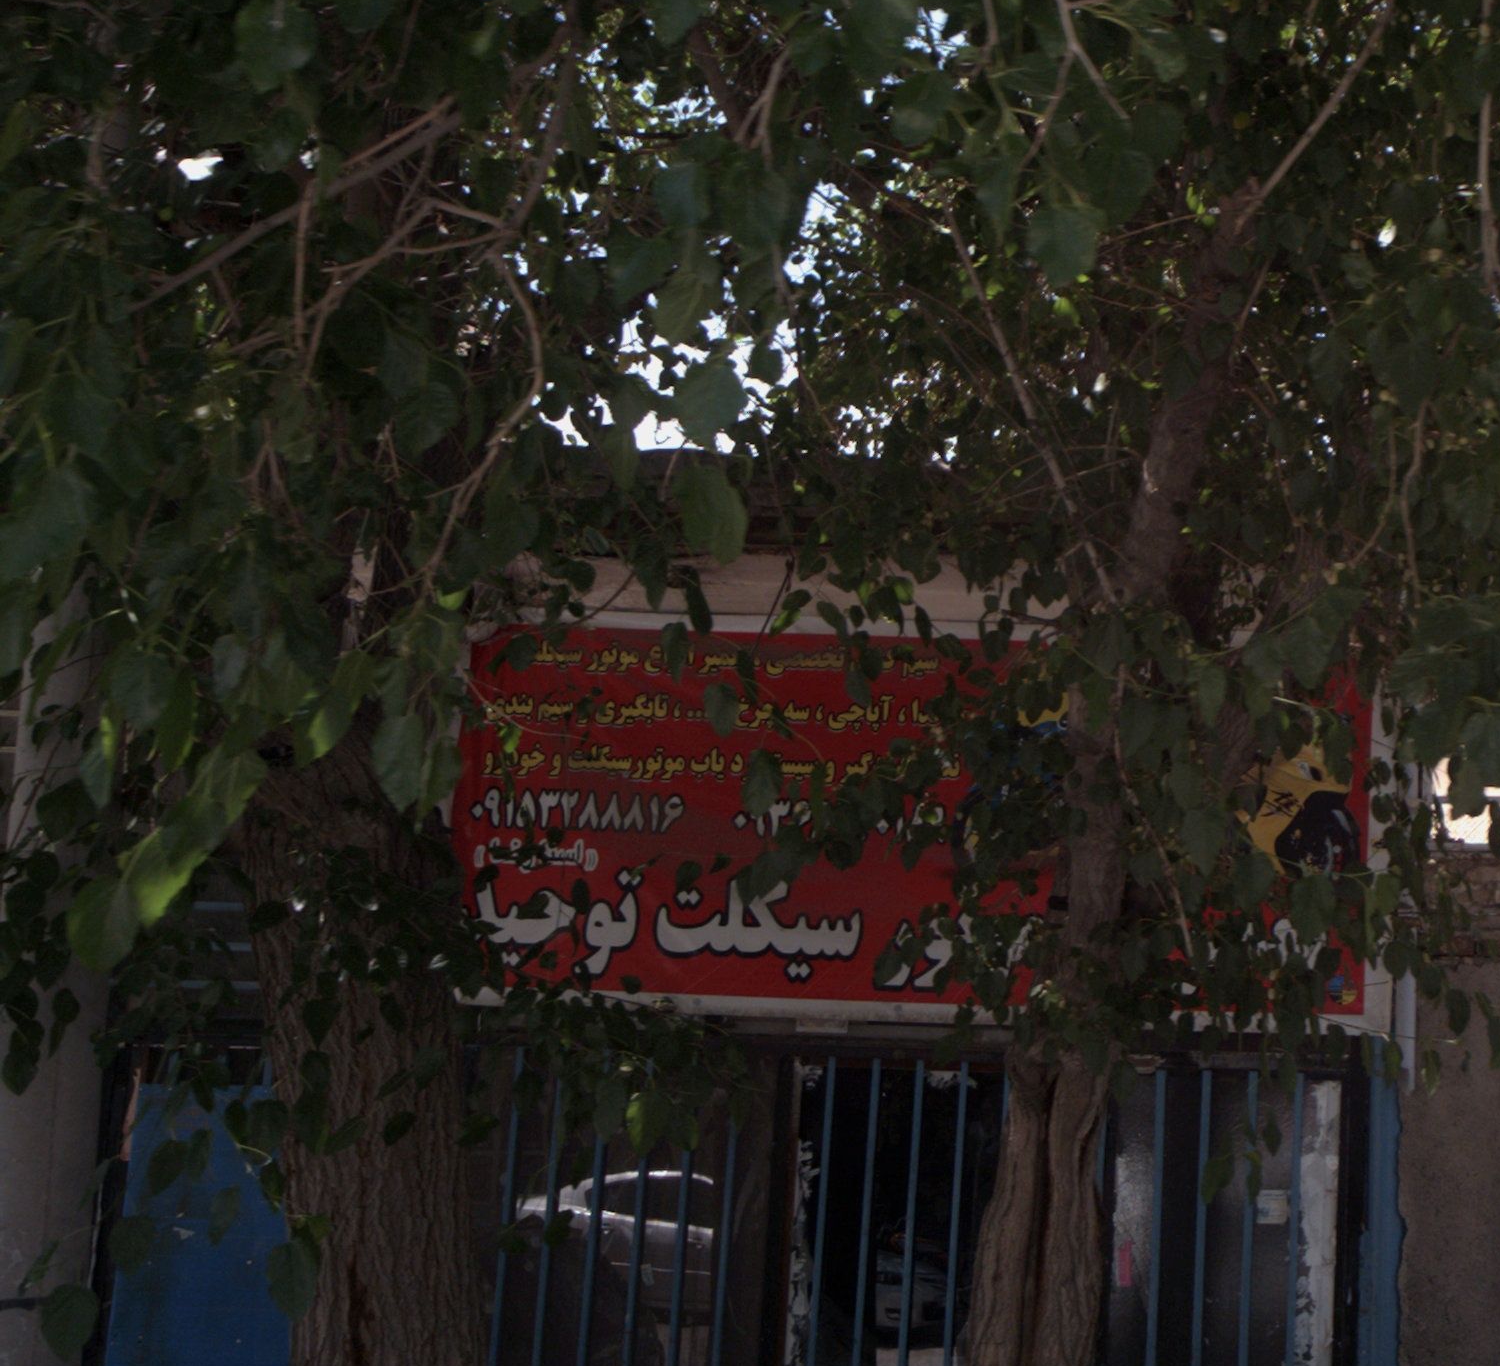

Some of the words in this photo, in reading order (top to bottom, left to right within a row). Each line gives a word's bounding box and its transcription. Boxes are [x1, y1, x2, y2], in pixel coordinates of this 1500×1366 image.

[522, 641, 583, 670] سیکل
[586, 642, 639, 673] موتور
[485, 693, 535, 726] بندی
[537, 701, 574, 724] سیم
[596, 694, 669, 725] تابگیری
[784, 702, 810, 722] سه
[828, 695, 895, 731] آپاچی
[549, 751, 562, 778] و
[655, 878, 862, 982] سیکلت
